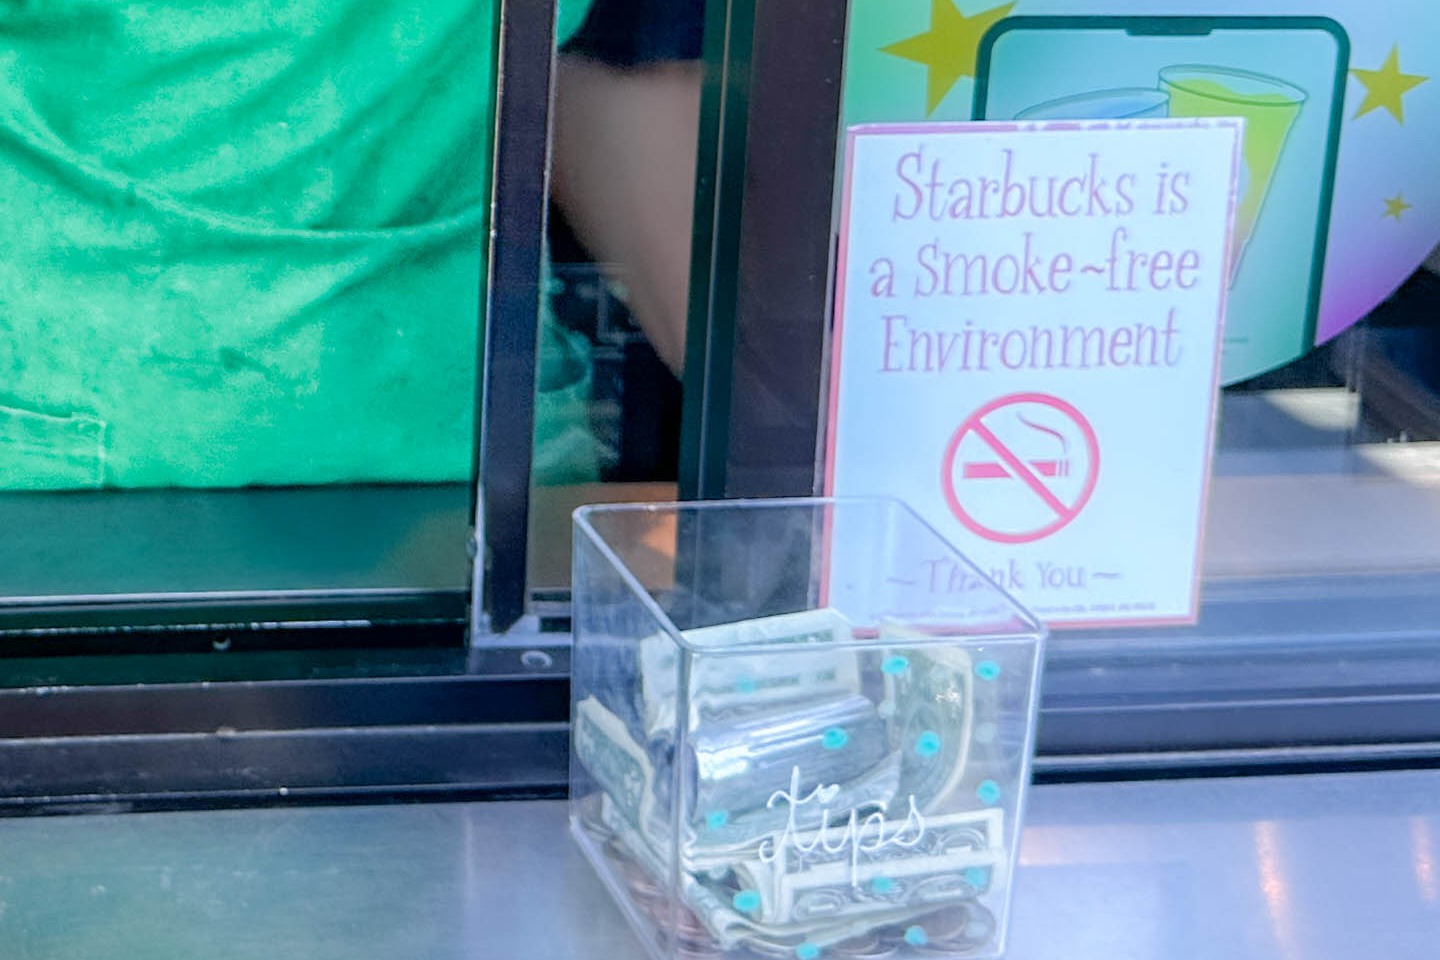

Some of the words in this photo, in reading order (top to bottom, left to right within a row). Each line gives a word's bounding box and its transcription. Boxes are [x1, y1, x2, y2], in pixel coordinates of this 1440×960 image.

[893, 144, 1136, 222] Starbucks
[1154, 163, 1190, 215] is
[868, 257, 896, 298] a
[878, 307, 1182, 373] Environment
[1036, 561, 1087, 589] You
[759, 766, 925, 887] tips
